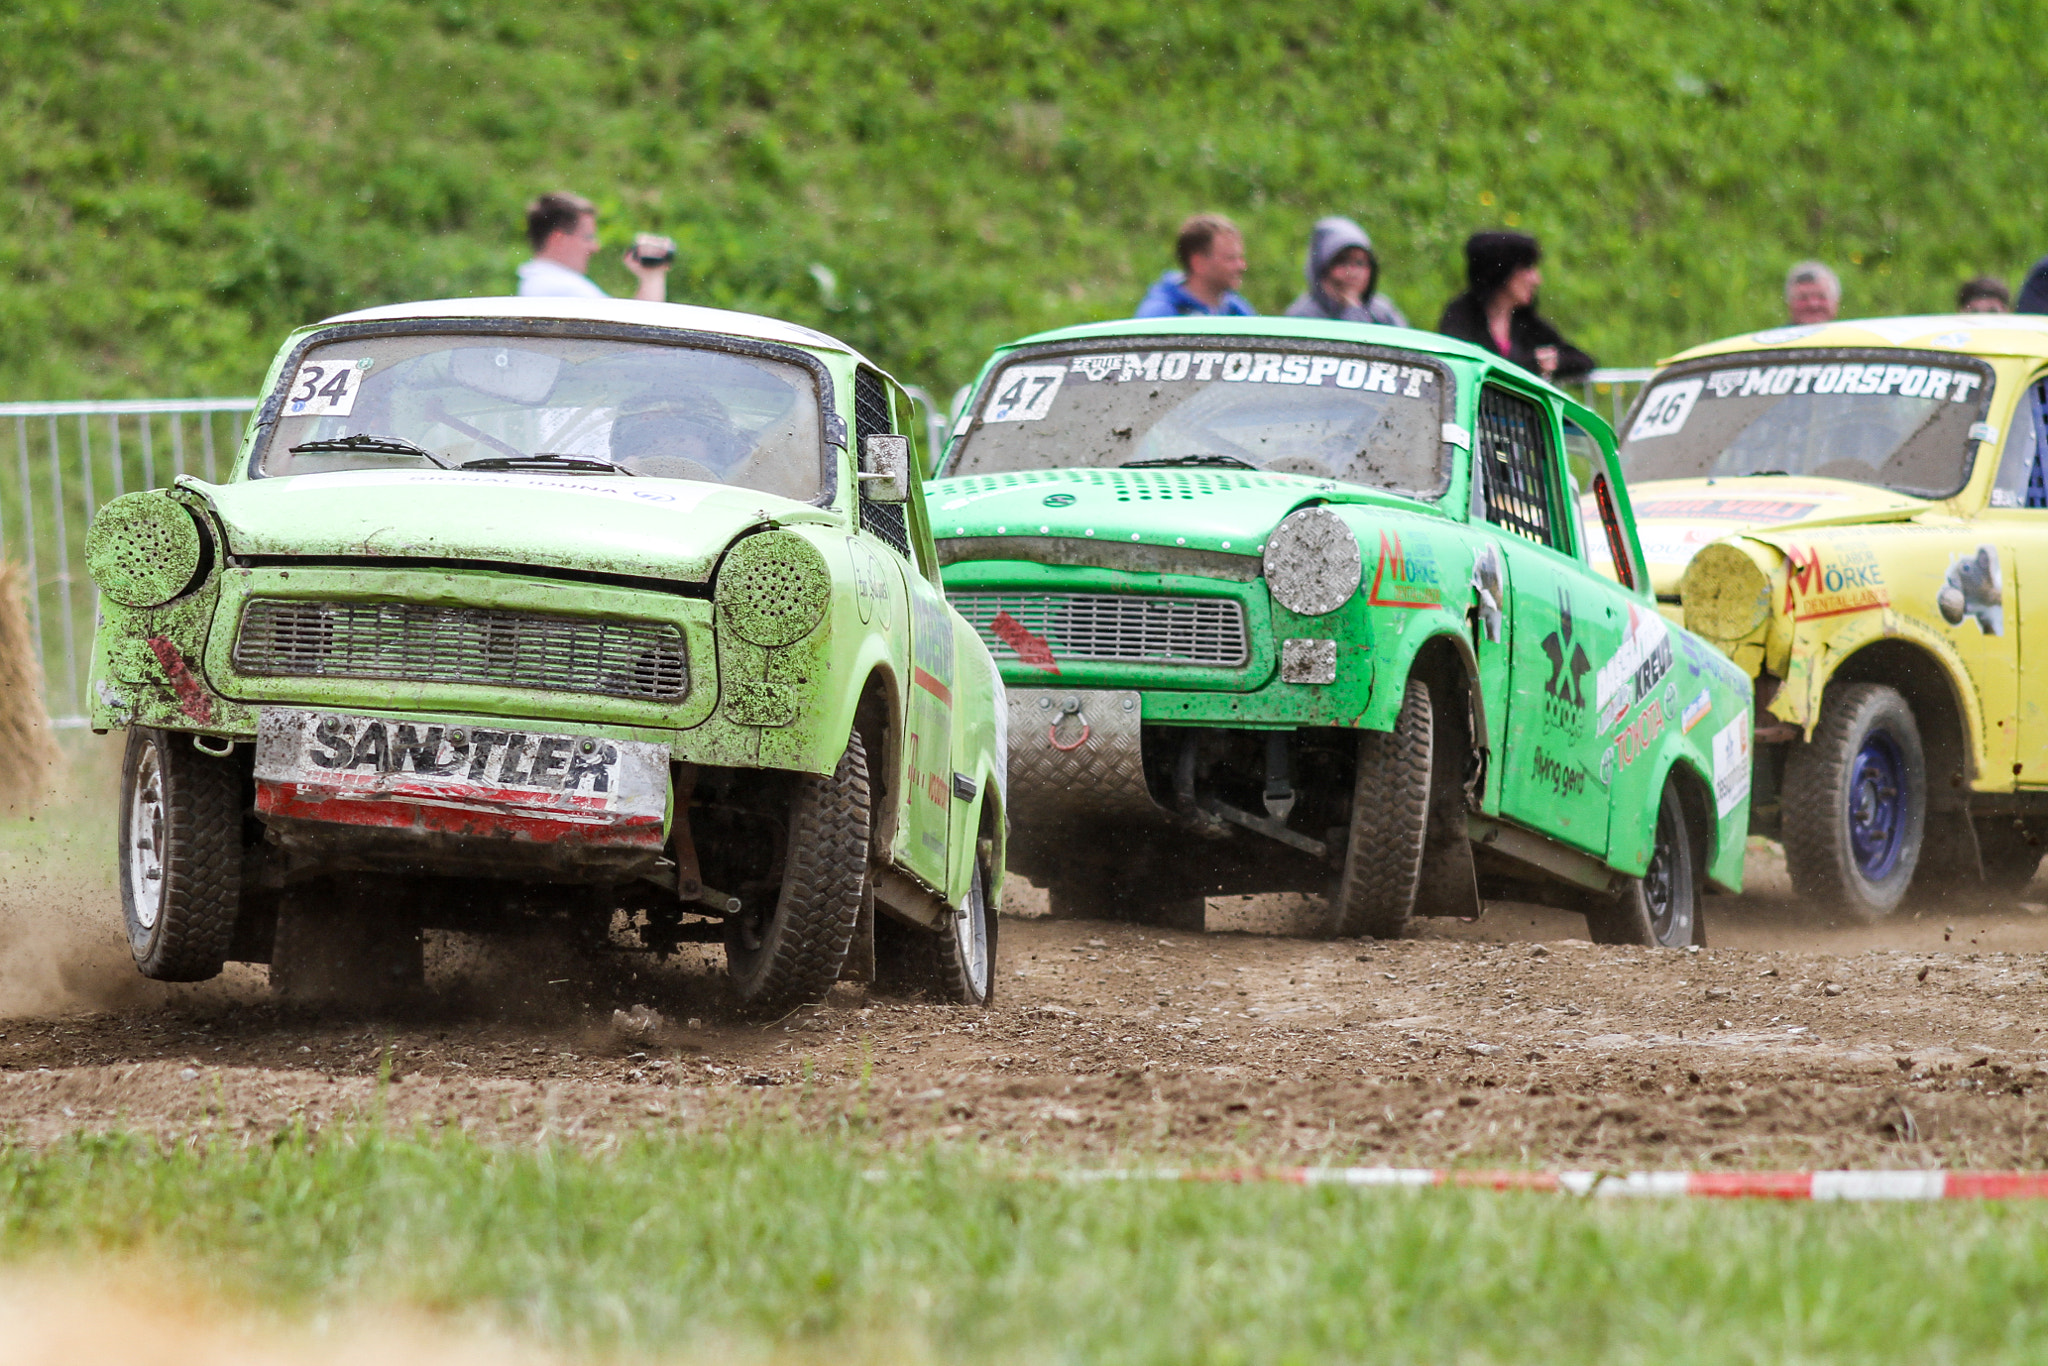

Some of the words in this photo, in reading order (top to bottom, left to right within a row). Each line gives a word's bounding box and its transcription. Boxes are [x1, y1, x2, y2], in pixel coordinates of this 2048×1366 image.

[291, 366, 351, 406] 34
[998, 376, 1056, 411] 47
[1118, 351, 1434, 398] MOTORSPORT
[1739, 364, 1981, 403] MOTORSPORT
[1645, 391, 1682, 426] 46
[528, 481, 618, 494] IDUNA
[1784, 544, 1885, 606] MÖRKE
[1615, 698, 1664, 772] TOYOTA
[308, 720, 618, 793] SANDTLER
